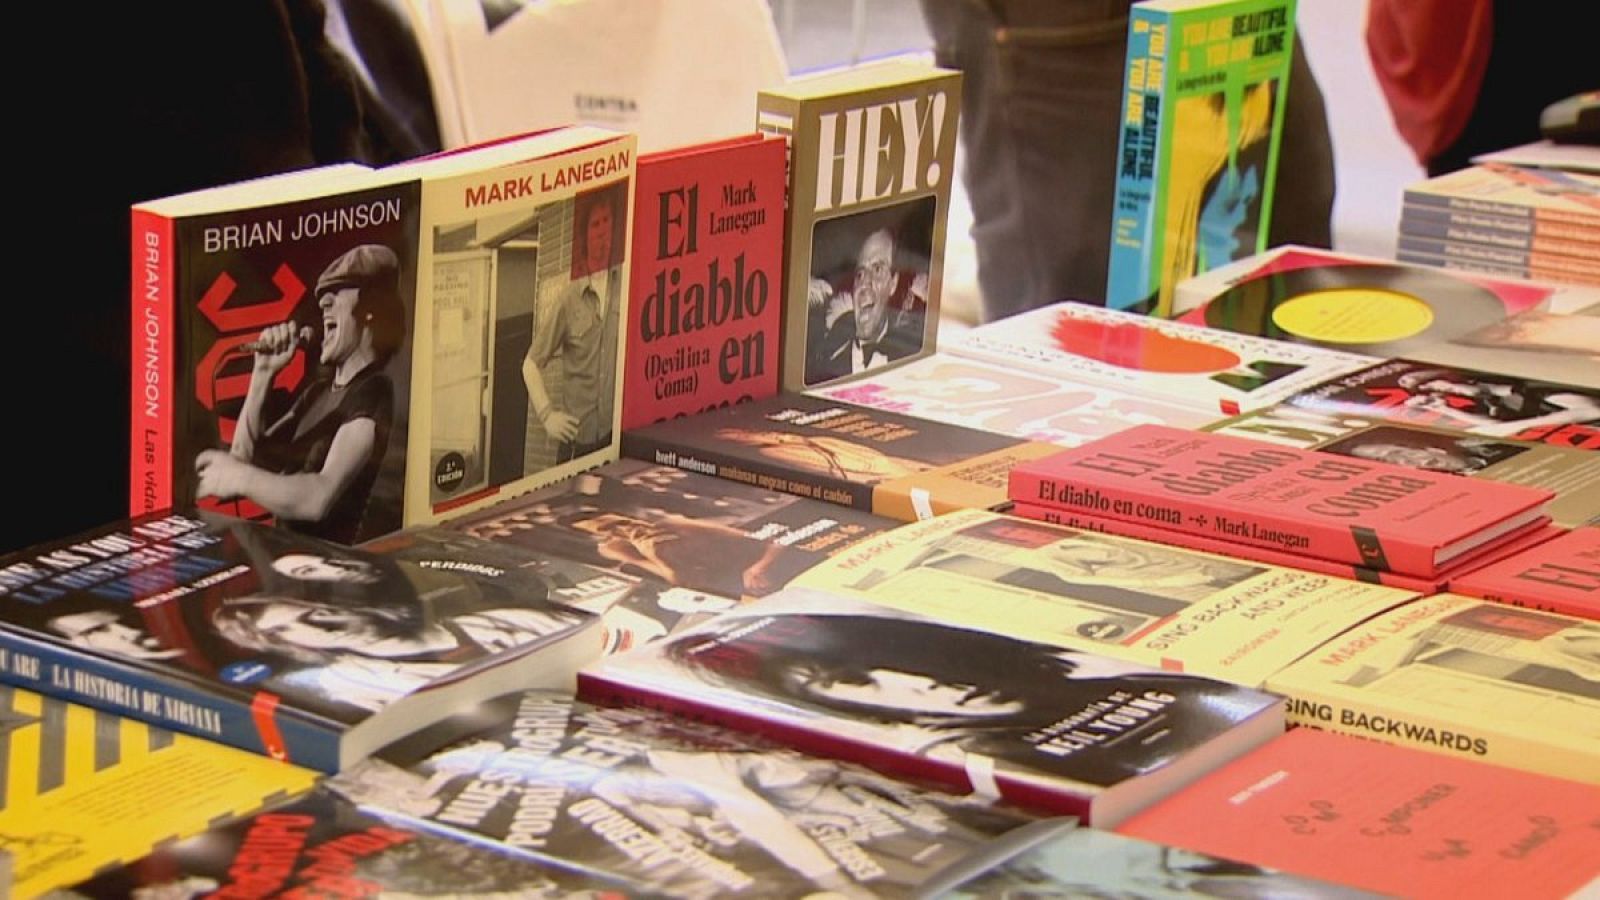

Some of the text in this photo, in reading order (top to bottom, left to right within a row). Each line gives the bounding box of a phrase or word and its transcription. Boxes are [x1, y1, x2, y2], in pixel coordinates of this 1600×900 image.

[1232, 6, 1288, 37] BEAUTIFUL
[465, 149, 630, 209] MARK LANEGAN
[814, 91, 947, 213] HEY!
[656, 181, 699, 261] El
[709, 206, 766, 236] Lanegan
[720, 180, 758, 209] Mark
[204, 199, 401, 253] BRIAN JOHNSON
[144, 231, 160, 301] BRIAN
[639, 251, 769, 344] diablo
[144, 308, 160, 418] JOHNSON
[718, 330, 765, 385] en
[654, 373, 699, 400] Coma)
[145, 429, 158, 465] Las
[655, 448, 677, 468] brett
[677, 456, 717, 476] anderson
[758, 474, 788, 491] negras
[788, 481, 812, 497] como
[1151, 449, 1302, 496] diablo
[1038, 479, 1055, 501] El
[1058, 484, 1111, 513] diablo
[1113, 496, 1133, 516] en
[1135, 504, 1182, 526] coma
[1213, 515, 1251, 539] Mark
[1251, 522, 1310, 550] Lanegan
[1145, 619, 1199, 652] SING
[1319, 633, 1380, 667] MARK
[12, 655, 41, 681] ARE
[53, 663, 71, 690] LA
[74, 668, 141, 710] HISTORIA
[142, 690, 162, 717] DE
[164, 695, 222, 736] NIRVANA
[1035, 729, 1107, 758] NEIL
[1088, 690, 1177, 733] YOUNG
[1285, 696, 1333, 722] SING
[1340, 706, 1489, 757] BACKWARDS
